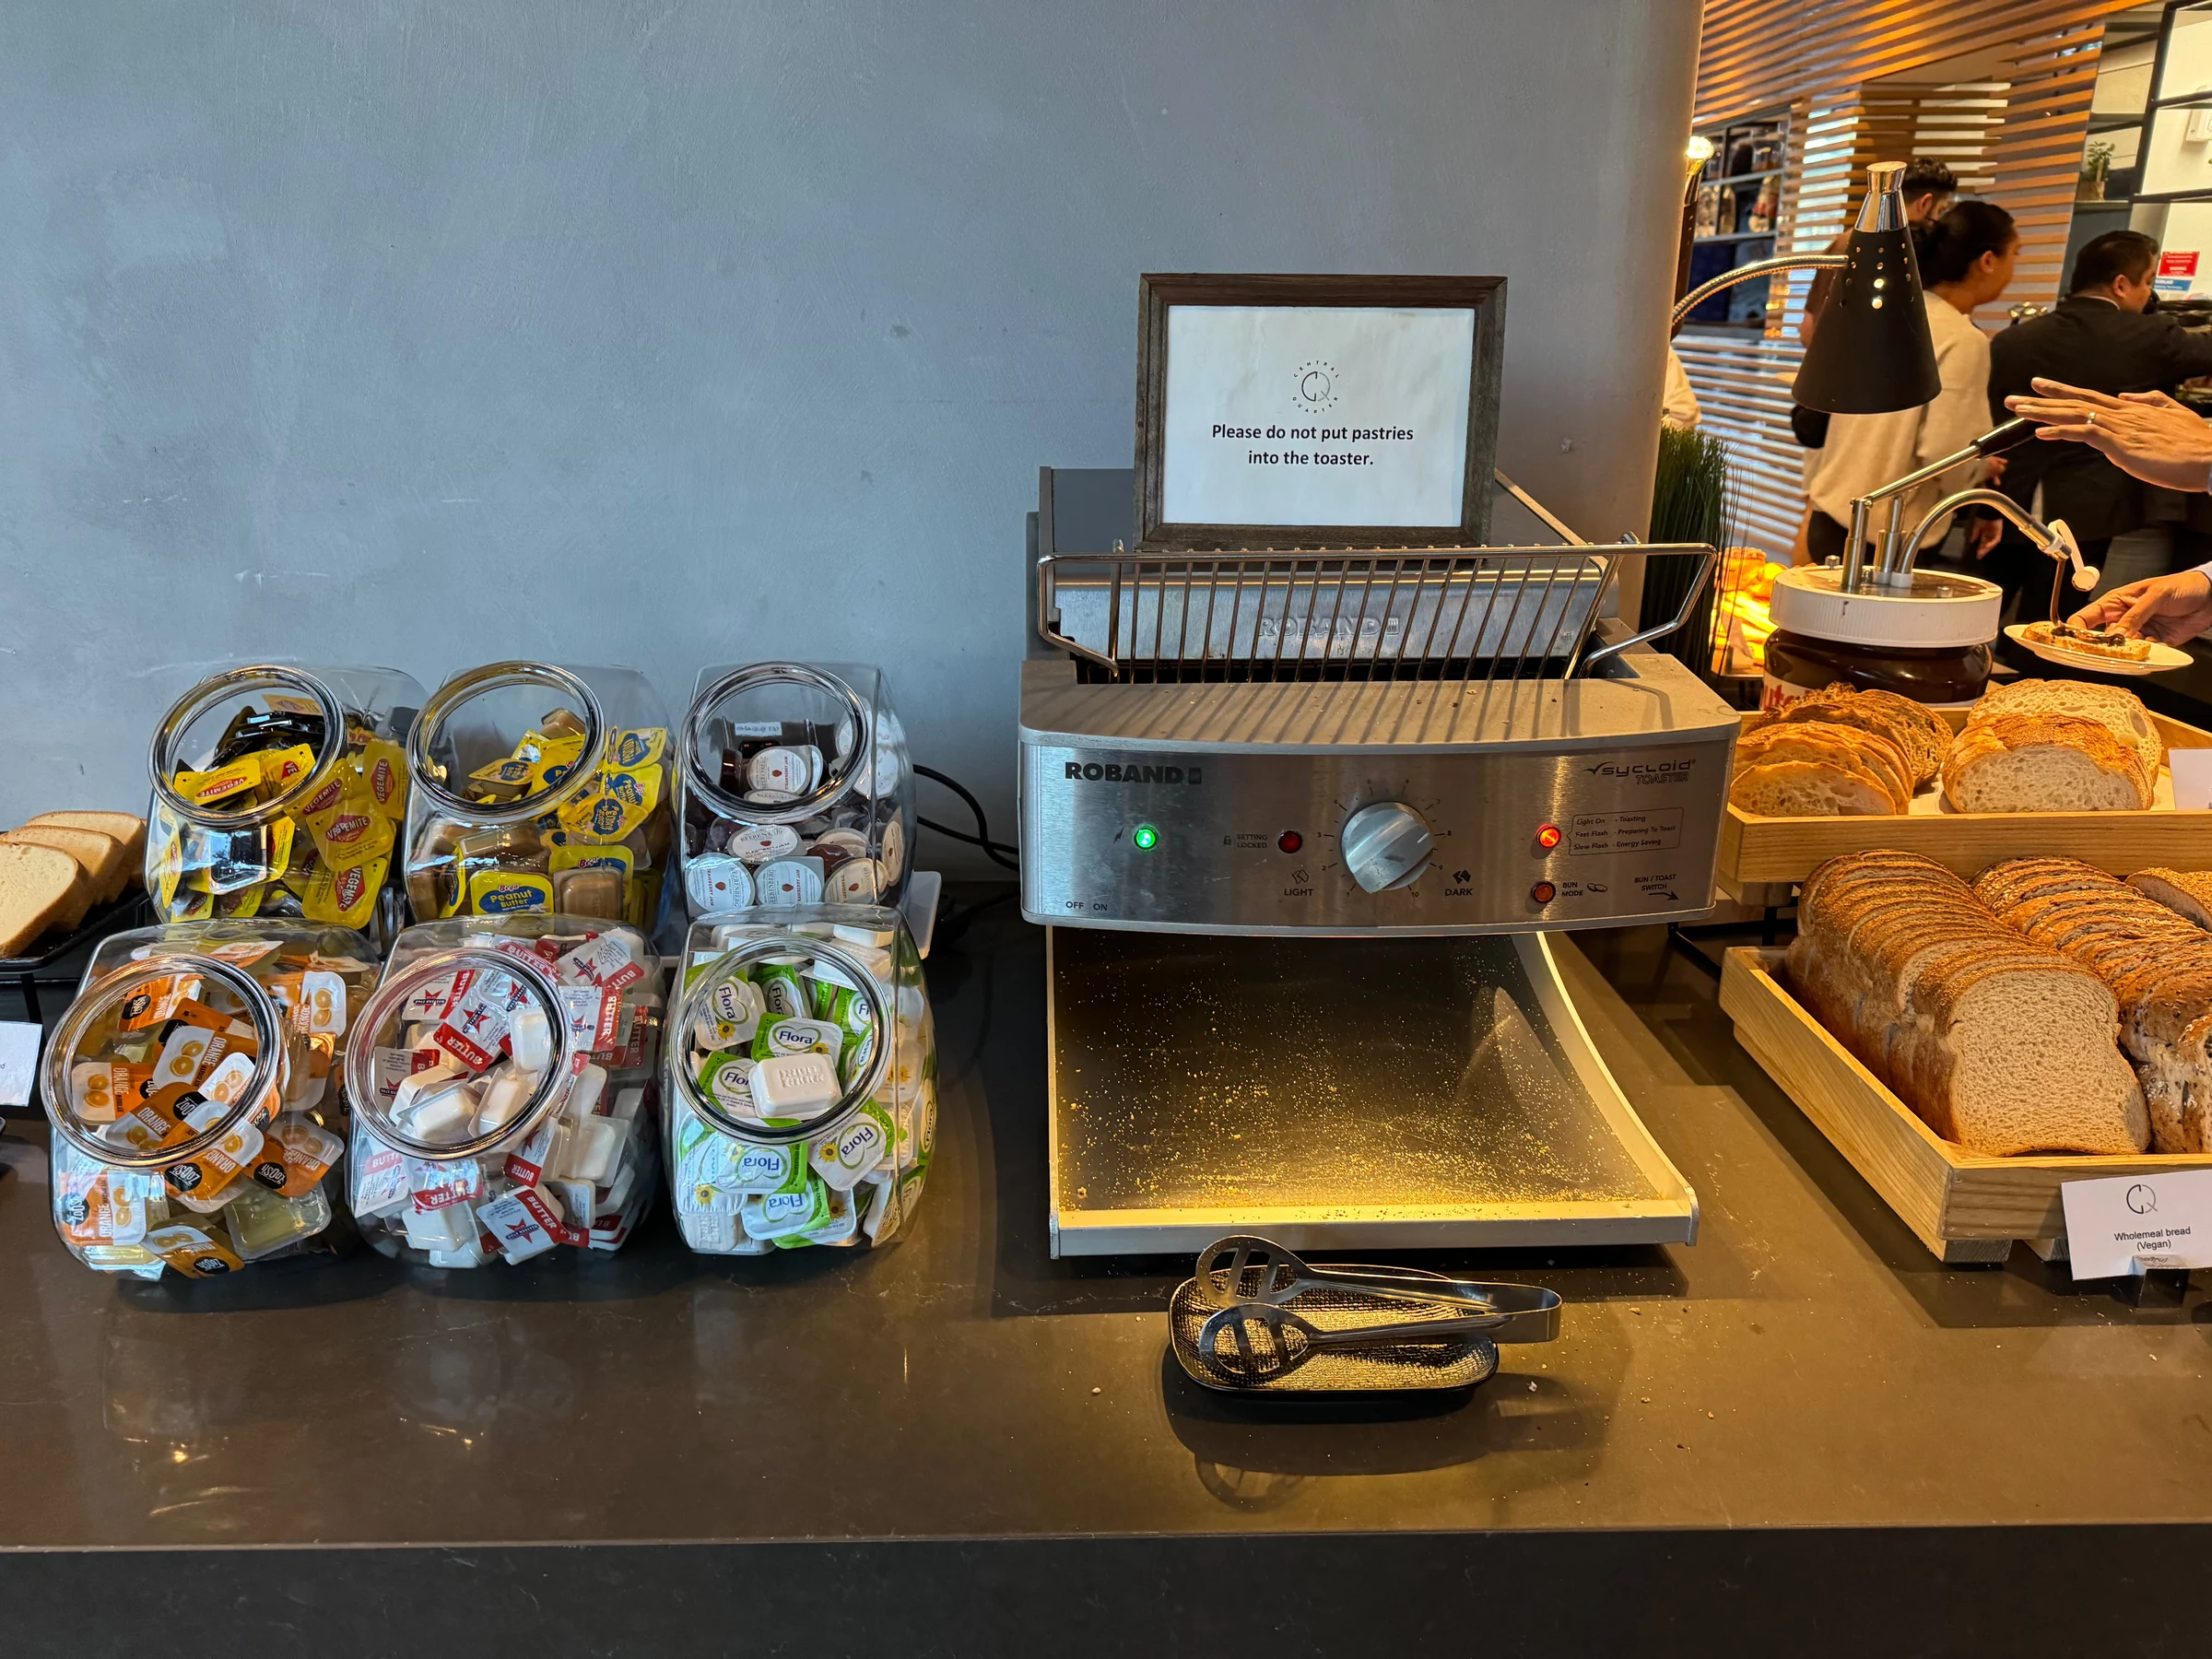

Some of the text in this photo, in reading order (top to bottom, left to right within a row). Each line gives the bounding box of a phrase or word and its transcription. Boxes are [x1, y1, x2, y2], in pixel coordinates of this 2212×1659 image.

[1212, 424, 1414, 443] Please do not put pastries
[1248, 451, 1374, 465] into the toaster.
[377, 760, 389, 803] VEGEMITE
[1065, 762, 1184, 784] ROBAND
[1635, 771, 1690, 785] TOASTER
[304, 779, 342, 813] VEGEMITE
[490, 889, 533, 902] Peanut
[1284, 888, 1314, 897] LIGHT
[1444, 888, 1473, 897] DARK
[500, 898, 529, 908] Butter
[1065, 900, 1084, 910] OFF
[1093, 902, 1108, 911] ON
[451, 972, 471, 1008] BUTTER
[719, 986, 736, 1019] Flora
[630, 1015, 643, 1053] BUTTER
[779, 1030, 813, 1044] Flora
[205, 1037, 227, 1067] ORANGE
[447, 1036, 483, 1065] BUTTER
[113, 1067, 129, 1095] ORANGE
[137, 1107, 171, 1134] ORANGE
[841, 1126, 875, 1156] Flora
[512, 1163, 535, 1182] BUTTER
[744, 1157, 781, 1171] Flora
[769, 1194, 804, 1208] Flora
[98, 1203, 112, 1237] ORANGE
[527, 1196, 558, 1229] BUTTER
[2113, 1226, 2192, 1241] Wholemeal bread
[2136, 1239, 2172, 1253] (Vegan)
